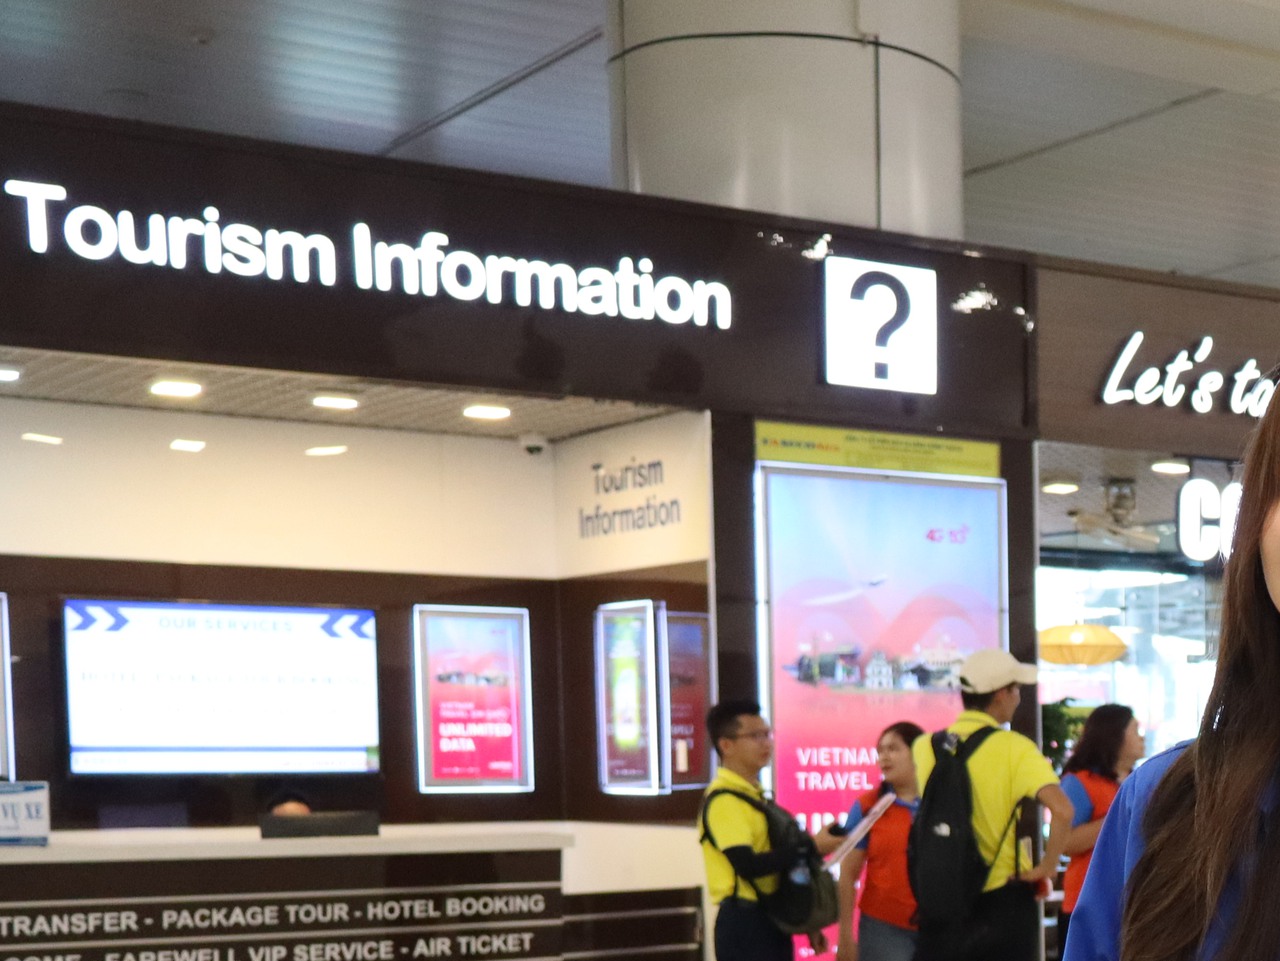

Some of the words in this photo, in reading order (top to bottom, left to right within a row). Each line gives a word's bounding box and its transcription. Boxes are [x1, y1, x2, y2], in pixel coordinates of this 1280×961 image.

[4, 178, 337, 286] Tourism
[353, 222, 732, 330] Information
[1103, 331, 1223, 413] Let's
[591, 456, 664, 494] Tourism
[579, 495, 681, 539] Information
[159, 616, 197, 629] OUR
[204, 617, 294, 632] SERVICES
[795, 771, 874, 791] TRAVEL
[0, 911, 139, 938] TRANSFER
[161, 905, 280, 930] PACKAGE
[285, 902, 350, 924] TOUR
[367, 899, 442, 921] HOTEL
[446, 894, 546, 917] BOOKING
[413, 936, 453, 959] AIR
[456, 932, 535, 956] TICKET
